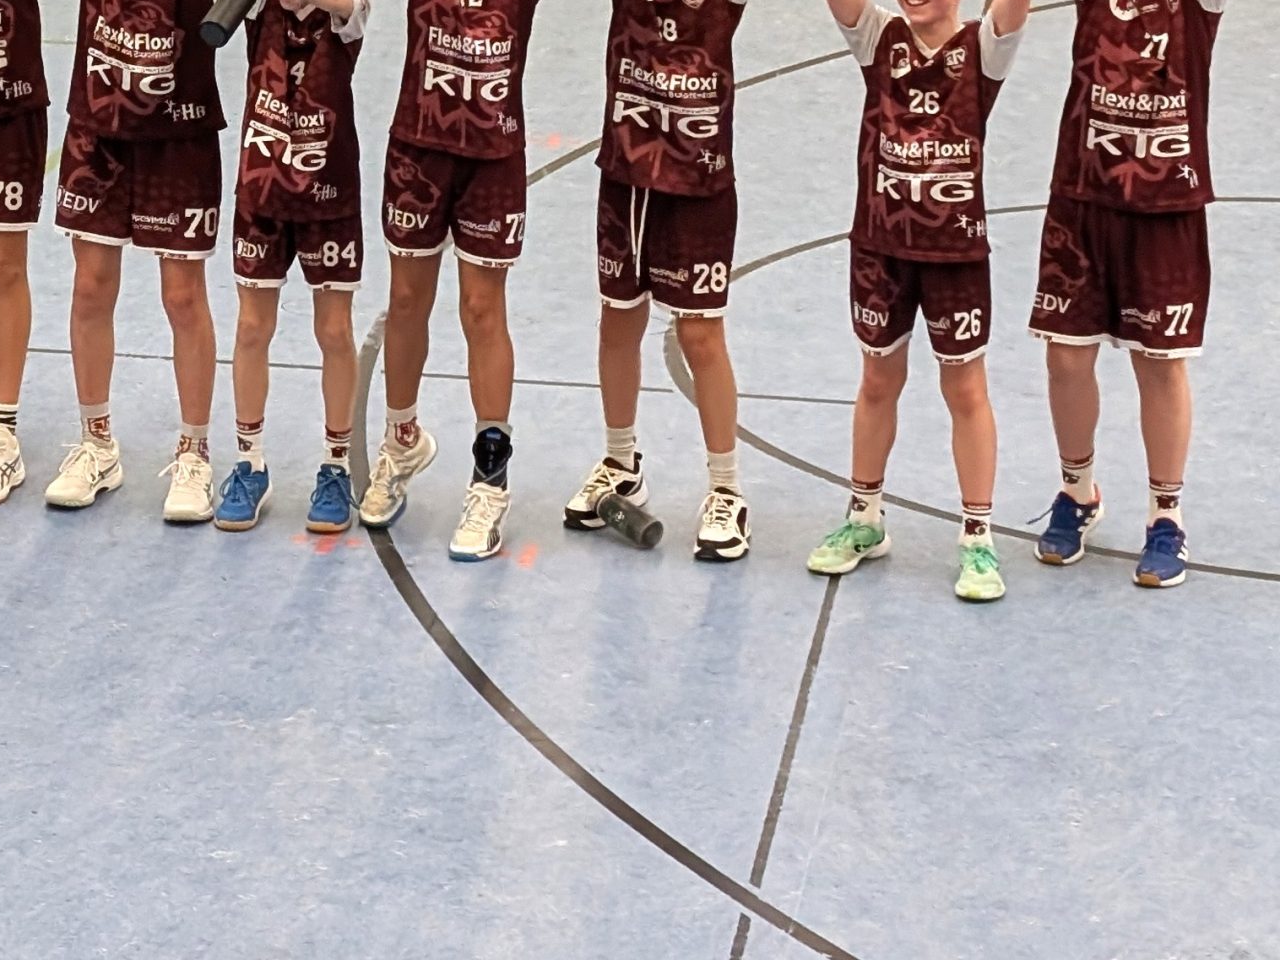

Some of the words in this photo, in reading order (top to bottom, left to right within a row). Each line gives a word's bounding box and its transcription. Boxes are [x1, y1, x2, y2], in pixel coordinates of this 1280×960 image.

[86, 54, 176, 95] KTG
[289, 60, 306, 86] 4
[423, 65, 510, 102] KTG
[619, 57, 718, 91] Flexi&Floxi
[908, 88, 940, 115] 26
[612, 100, 719, 139] KTG
[243, 126, 327, 172] KTG
[1086, 125, 1191, 159] KTG
[62, 191, 102, 215] EDV
[876, 171, 975, 203] KTG
[183, 207, 218, 239] 70
[395, 210, 429, 230] EDV
[322, 240, 357, 268] 84
[599, 255, 624, 279] EDV
[693, 261, 727, 294] 28
[862, 307, 890, 328] EDV
[1034, 291, 1073, 315] EDV
[954, 308, 983, 341] 26
[1163, 302, 1194, 337] 77
